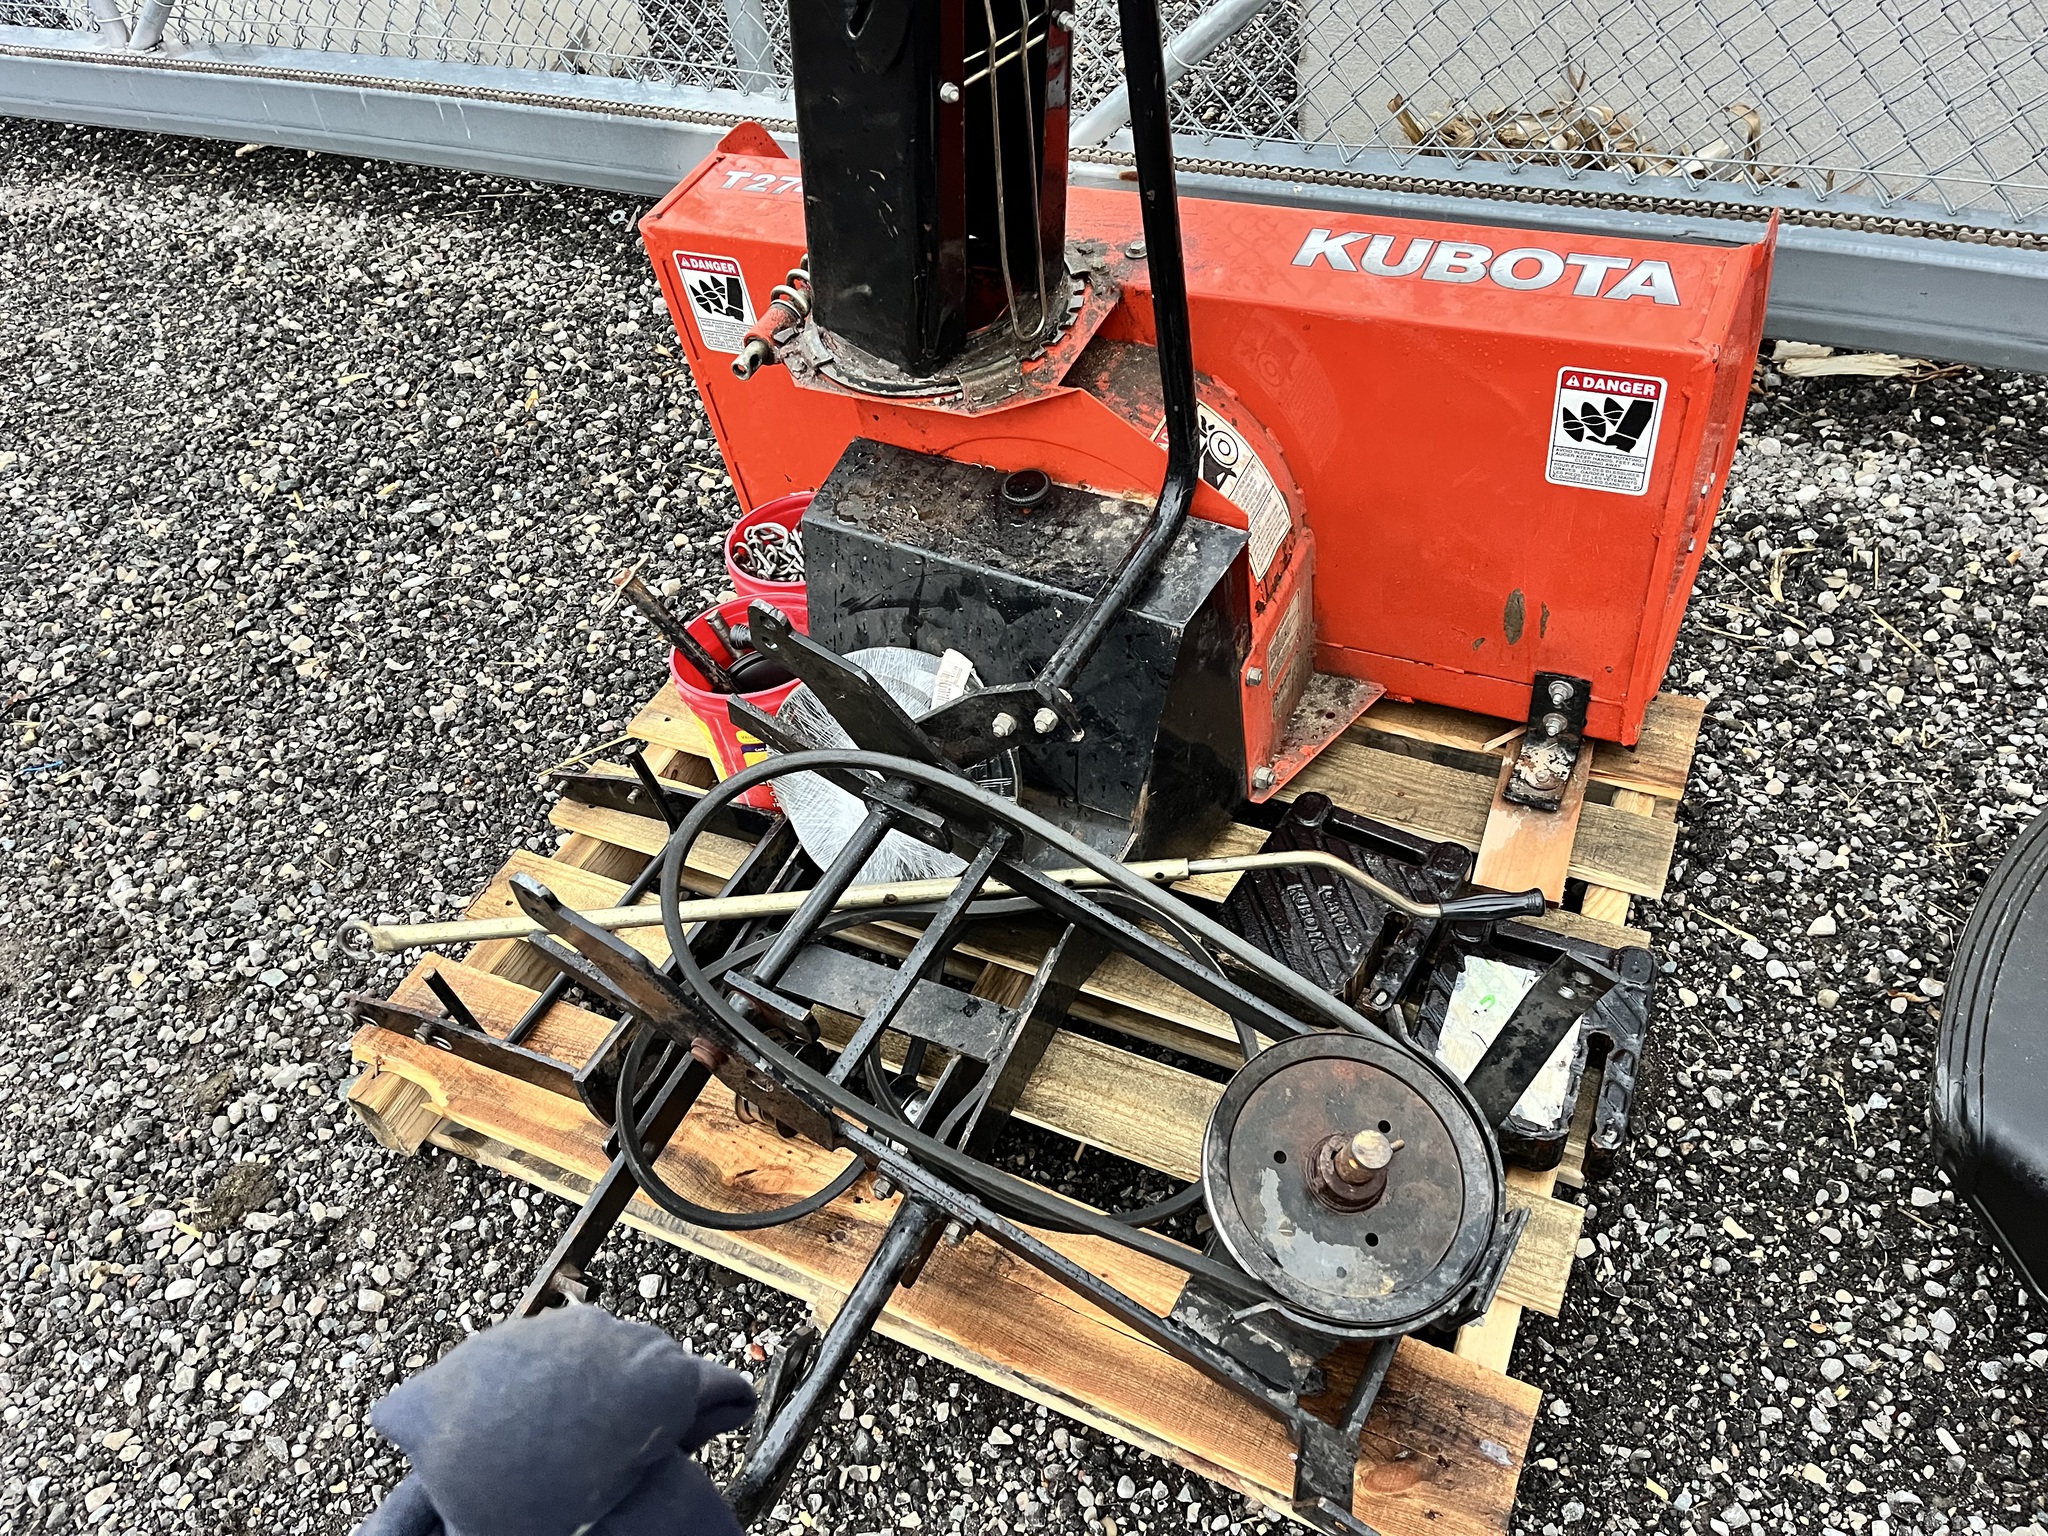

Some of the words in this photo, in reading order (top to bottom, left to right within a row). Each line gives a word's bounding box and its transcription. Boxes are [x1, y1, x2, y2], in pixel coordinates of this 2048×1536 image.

[690, 258, 736, 273] DANGER
[1291, 227, 1681, 306] KUBOTA
[1582, 376, 1656, 397] DANGER
